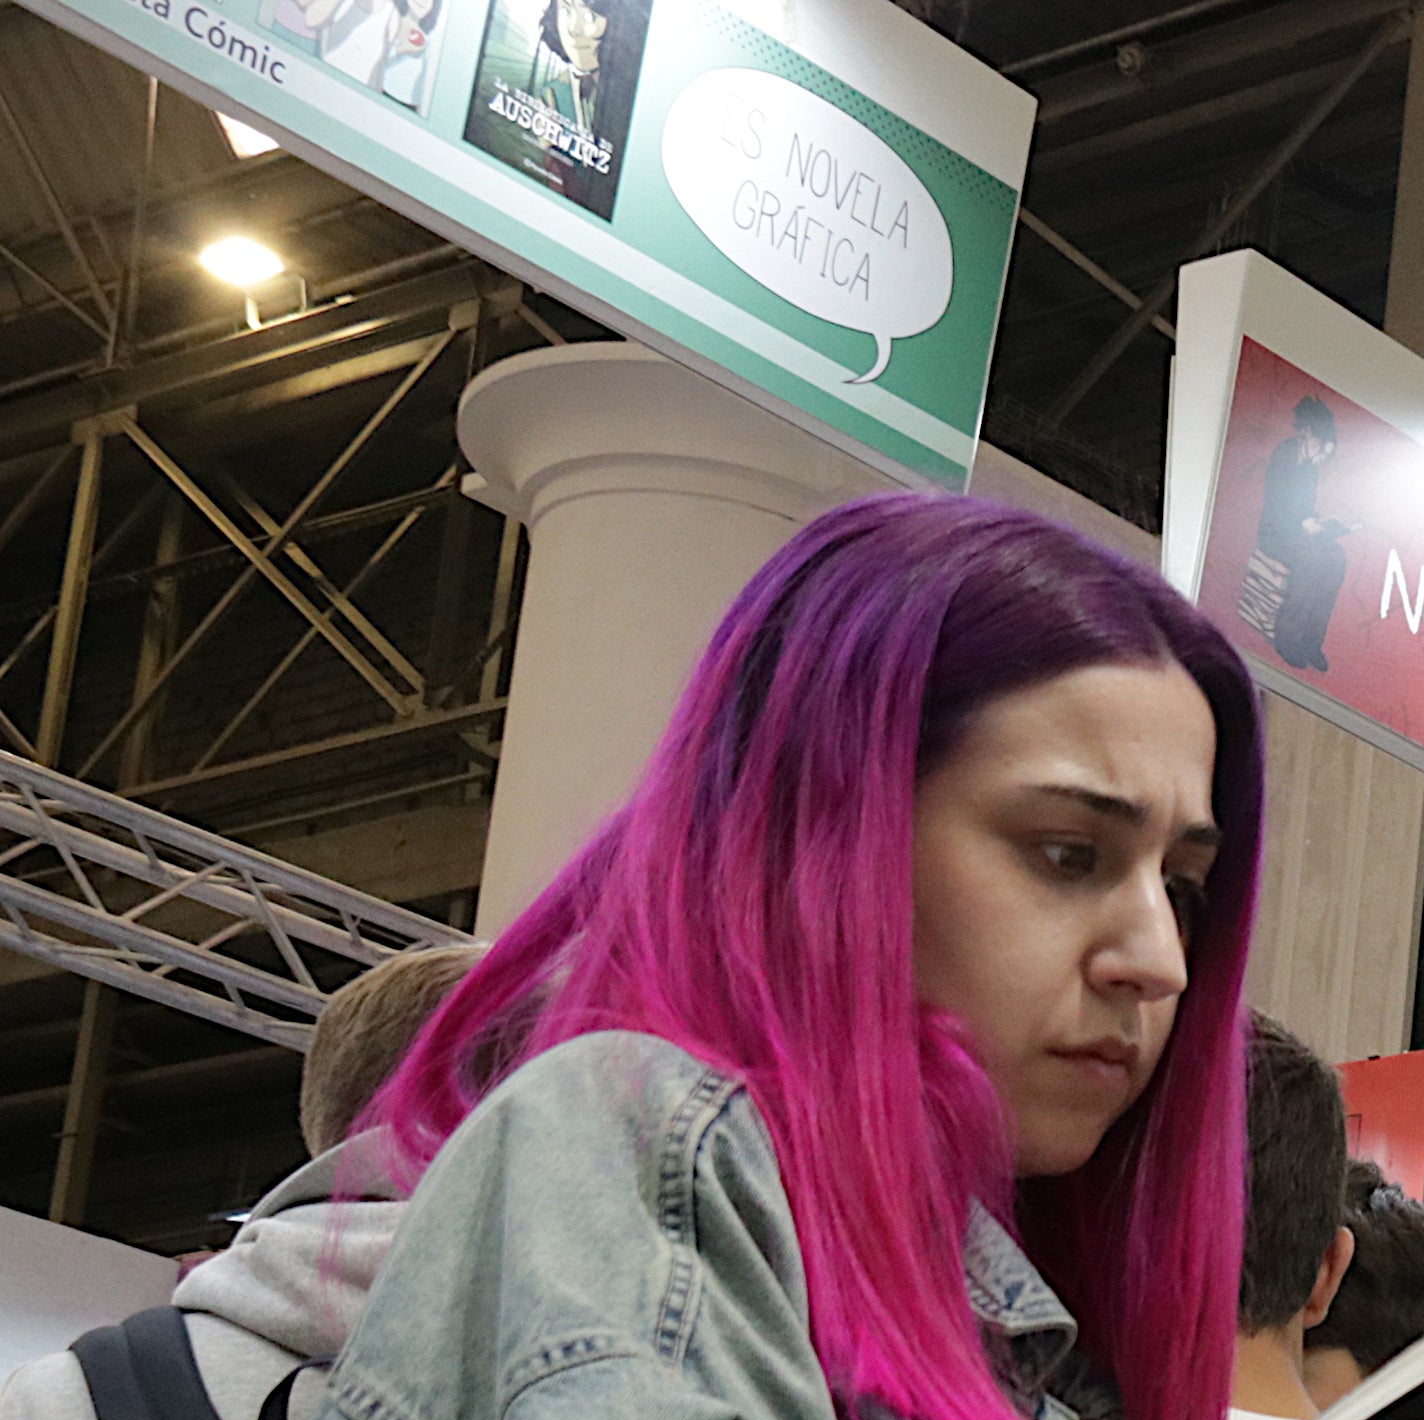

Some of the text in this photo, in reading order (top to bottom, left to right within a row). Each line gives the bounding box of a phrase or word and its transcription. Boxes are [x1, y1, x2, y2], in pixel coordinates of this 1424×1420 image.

[185, 7, 286, 84] Cómic
[488, 93, 612, 174] AUSCHWITZ
[720, 92, 909, 249] ES NOVELA
[733, 179, 870, 302] GRÁFICA
